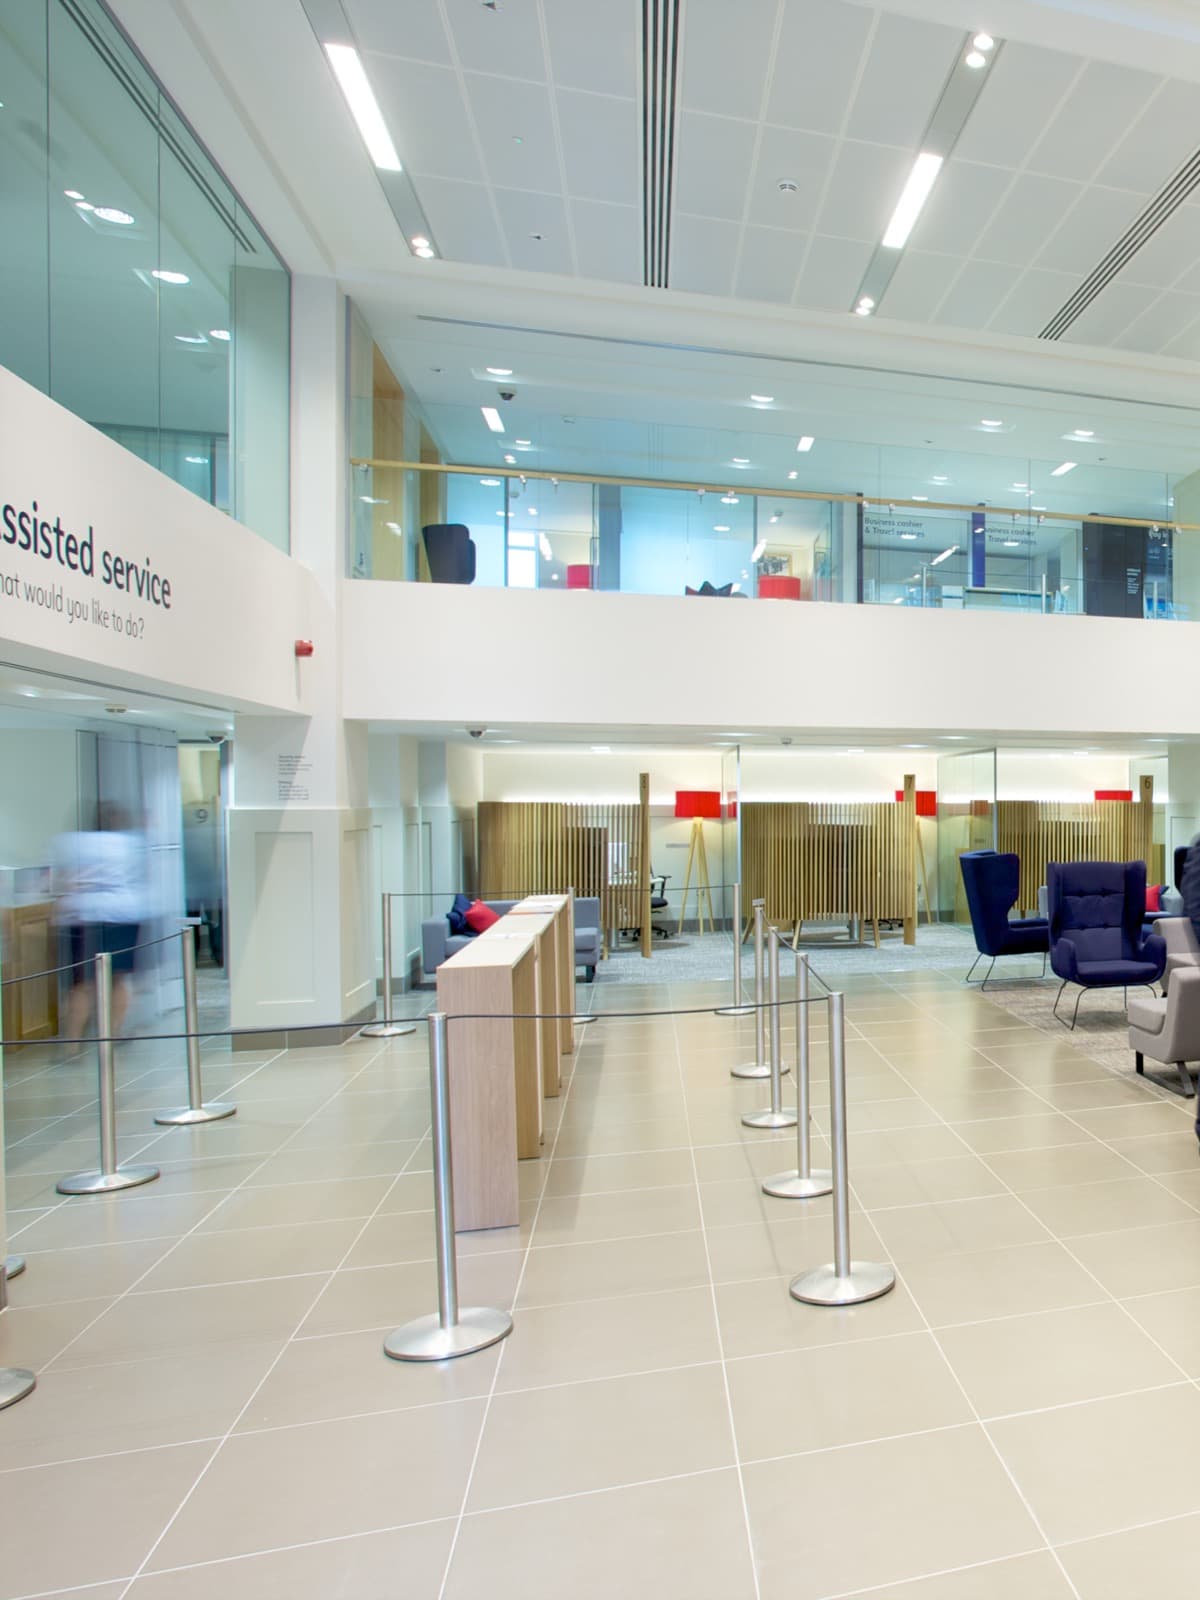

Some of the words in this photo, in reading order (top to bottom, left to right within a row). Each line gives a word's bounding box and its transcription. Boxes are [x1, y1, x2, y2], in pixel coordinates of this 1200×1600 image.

[0, 500, 95, 578] ssisted
[102, 550, 171, 609] service
[24, 581, 63, 613] would
[67, 597, 89, 624] you
[91, 598, 110, 629] like
[112, 609, 124, 633] to
[126, 612, 145, 640] do?
[1144, 777, 1152, 790] 6
[195, 808, 208, 824] 9
